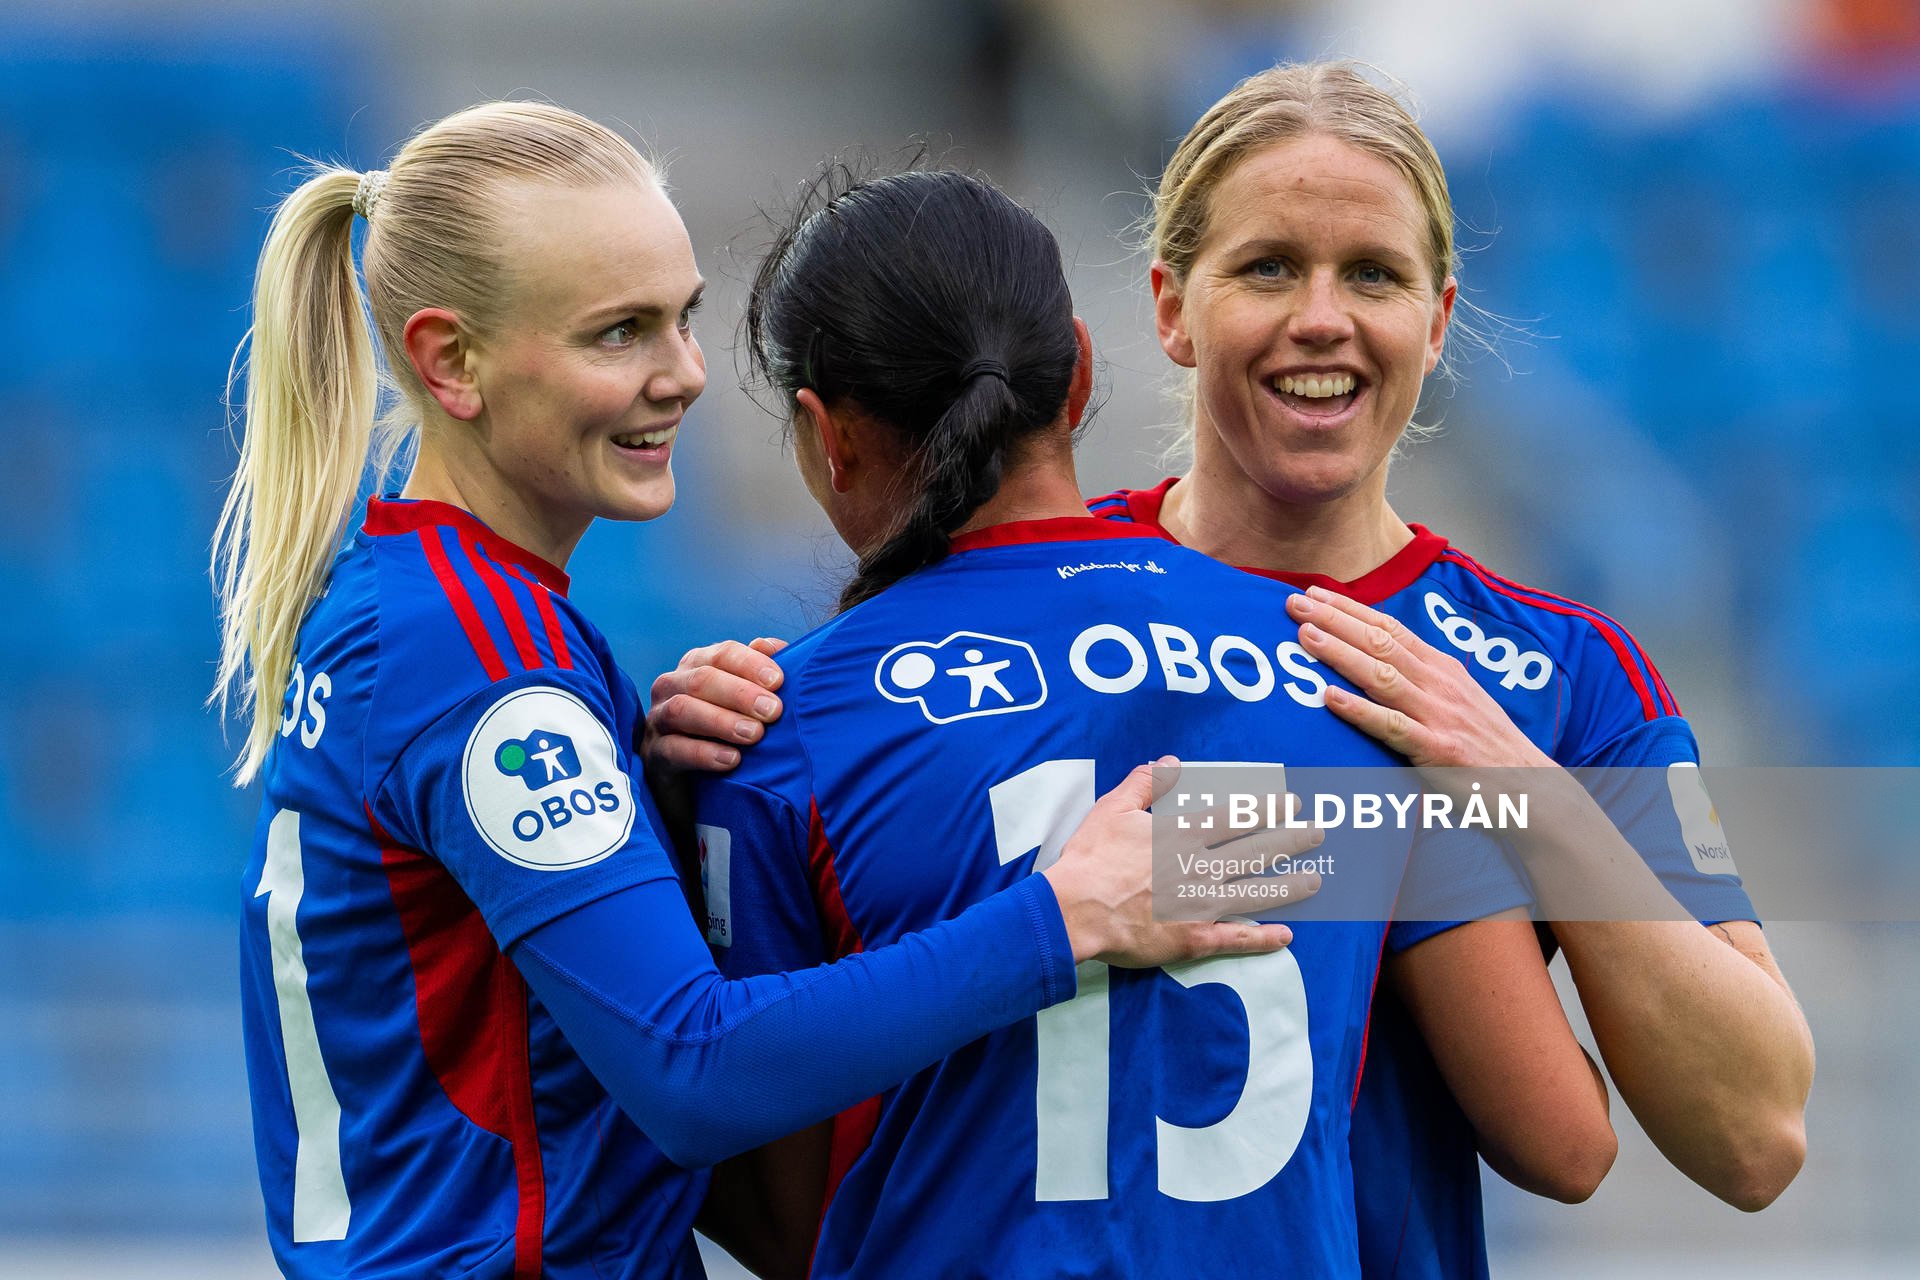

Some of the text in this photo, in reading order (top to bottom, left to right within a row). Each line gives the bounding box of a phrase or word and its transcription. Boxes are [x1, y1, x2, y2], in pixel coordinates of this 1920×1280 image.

[1069, 622, 1328, 709] OBOS
[512, 781, 620, 842] OBOS
[1695, 842, 1729, 860] Norsk
[988, 759, 1314, 1202] 15
